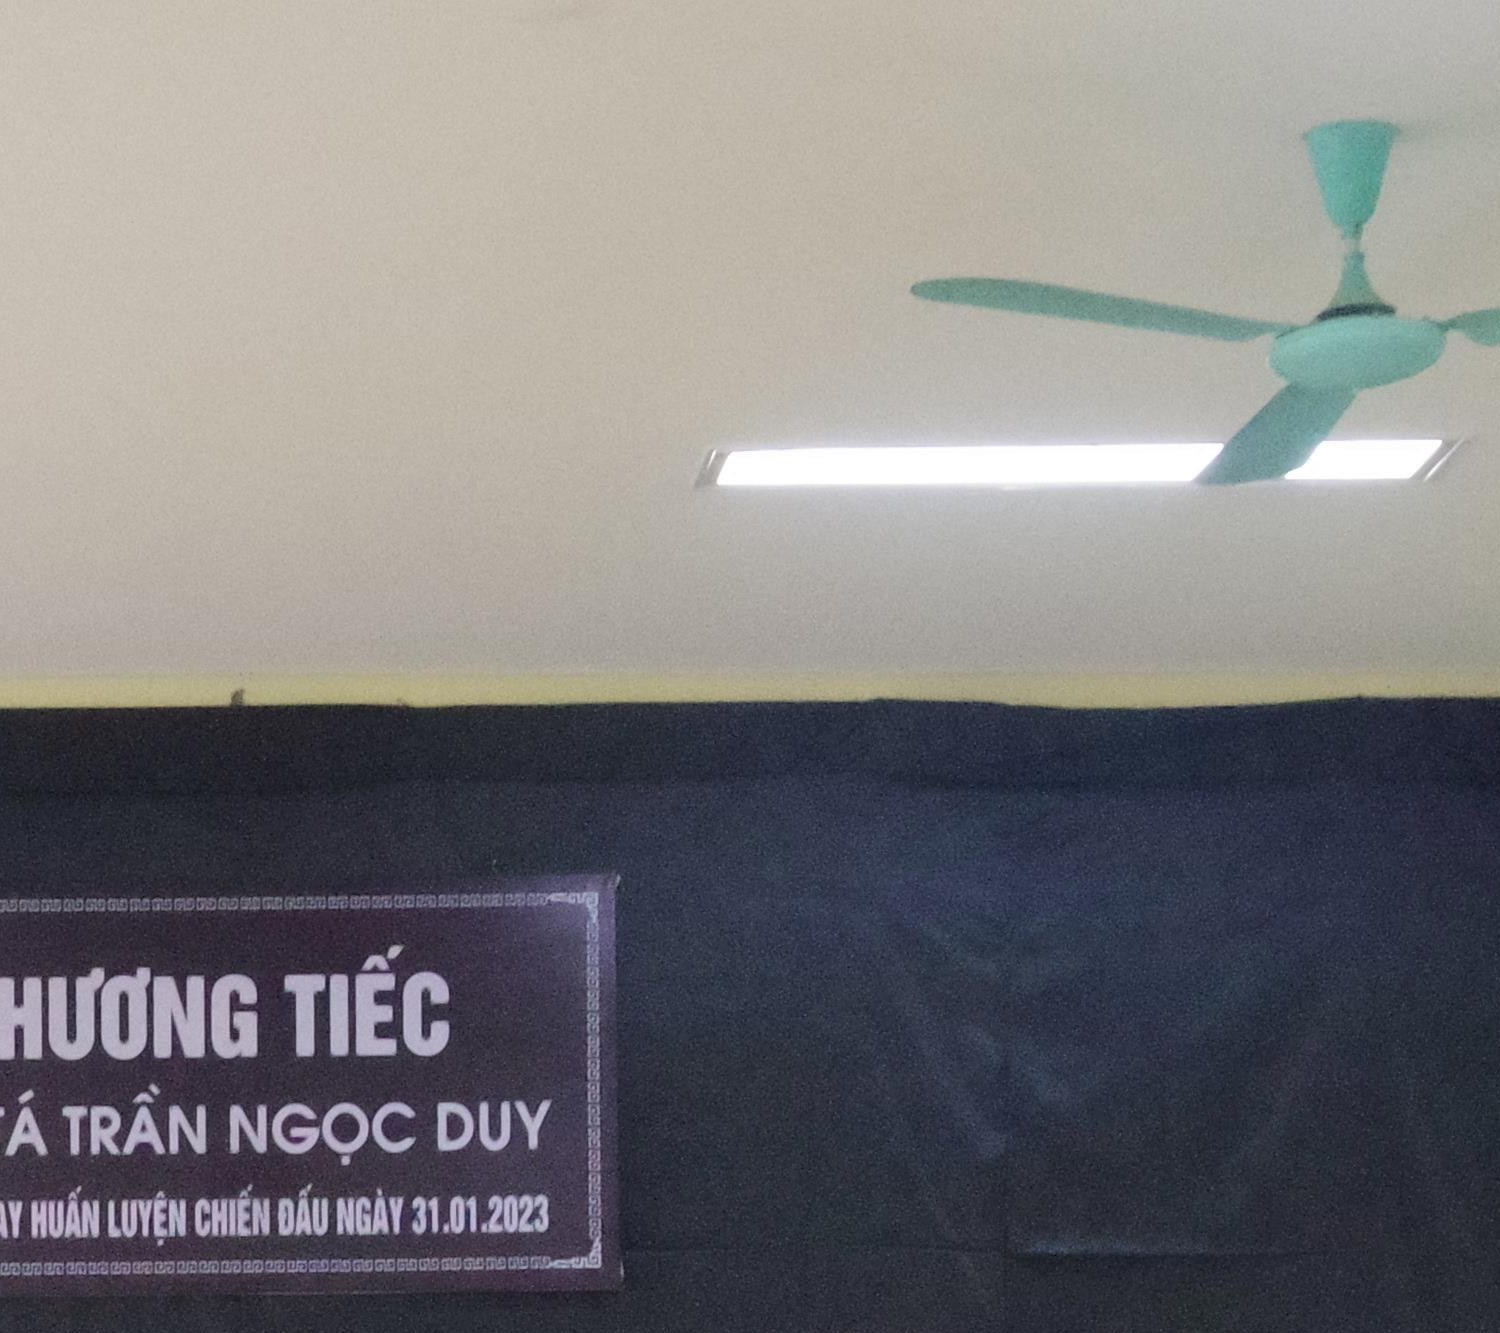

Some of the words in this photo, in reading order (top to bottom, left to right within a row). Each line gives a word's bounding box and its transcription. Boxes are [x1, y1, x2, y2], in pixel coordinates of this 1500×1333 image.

[284, 945, 450, 1058] TIẾC
[62, 1084, 207, 1156] TRẦN
[229, 1101, 416, 1166] NGỌC
[436, 1099, 552, 1153] DUY
[30, 1186, 100, 1239] HUẤN
[107, 1190, 187, 1246] LUYỆN
[194, 1184, 271, 1238] CHIẾN
[277, 1183, 329, 1236] ĐẤU
[336, 1188, 404, 1236] NGÀY
[411, 1193, 550, 1235] 31.01.2023
